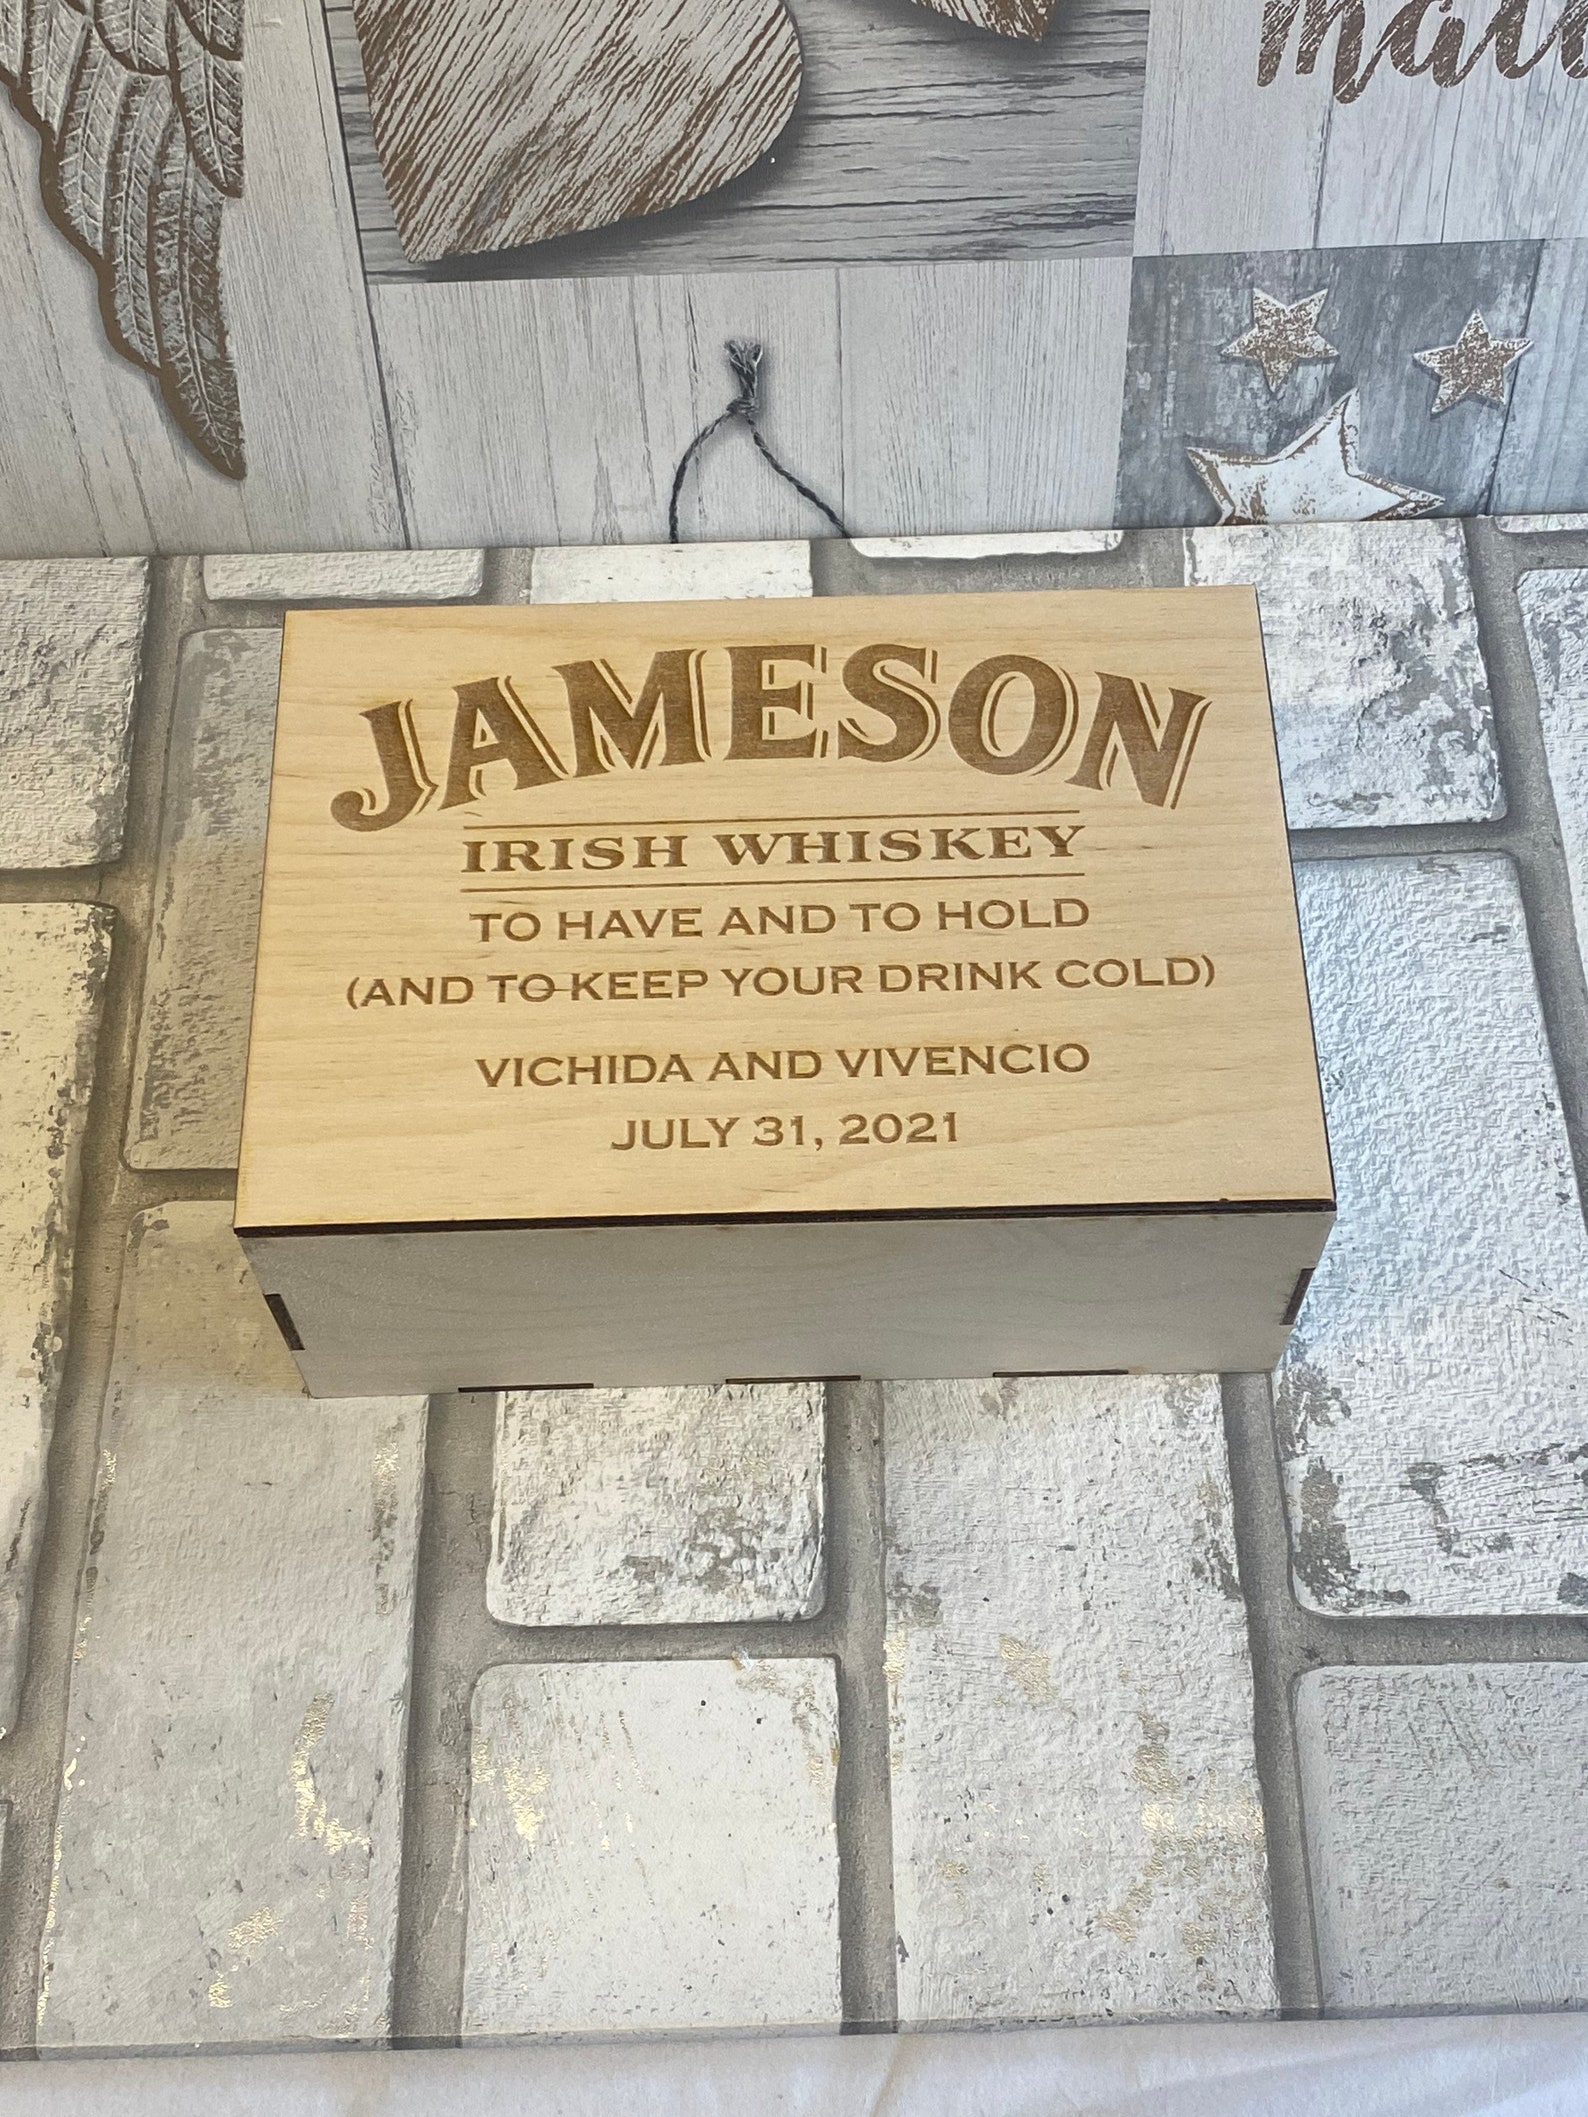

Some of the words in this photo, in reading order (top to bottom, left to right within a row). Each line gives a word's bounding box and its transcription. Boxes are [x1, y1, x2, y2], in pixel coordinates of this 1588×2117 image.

[330, 643, 1213, 833] JAMESON
[460, 834, 689, 873] IRISH
[711, 825, 1086, 866] WHISKEY
[468, 911, 542, 943] TO
[558, 907, 704, 941] HAVE
[718, 904, 837, 937] AND
[848, 902, 922, 933] TO
[937, 897, 1090, 931] HOLD
[346, 975, 474, 1010] (AND
[486, 973, 556, 1004] TO
[570, 968, 709, 1001] KEEP
[720, 965, 864, 998] YOUR
[878, 960, 1043, 993] DRINK
[1054, 953, 1216, 989] COLD)
[474, 1053, 695, 1088] VICHIDA
[706, 1049, 823, 1082] AND
[835, 1042, 1091, 1078] VIVENCIO
[610, 1116, 741, 1151] JULY
[751, 1114, 824, 1152] 31,
[837, 1110, 959, 1146] 2021
